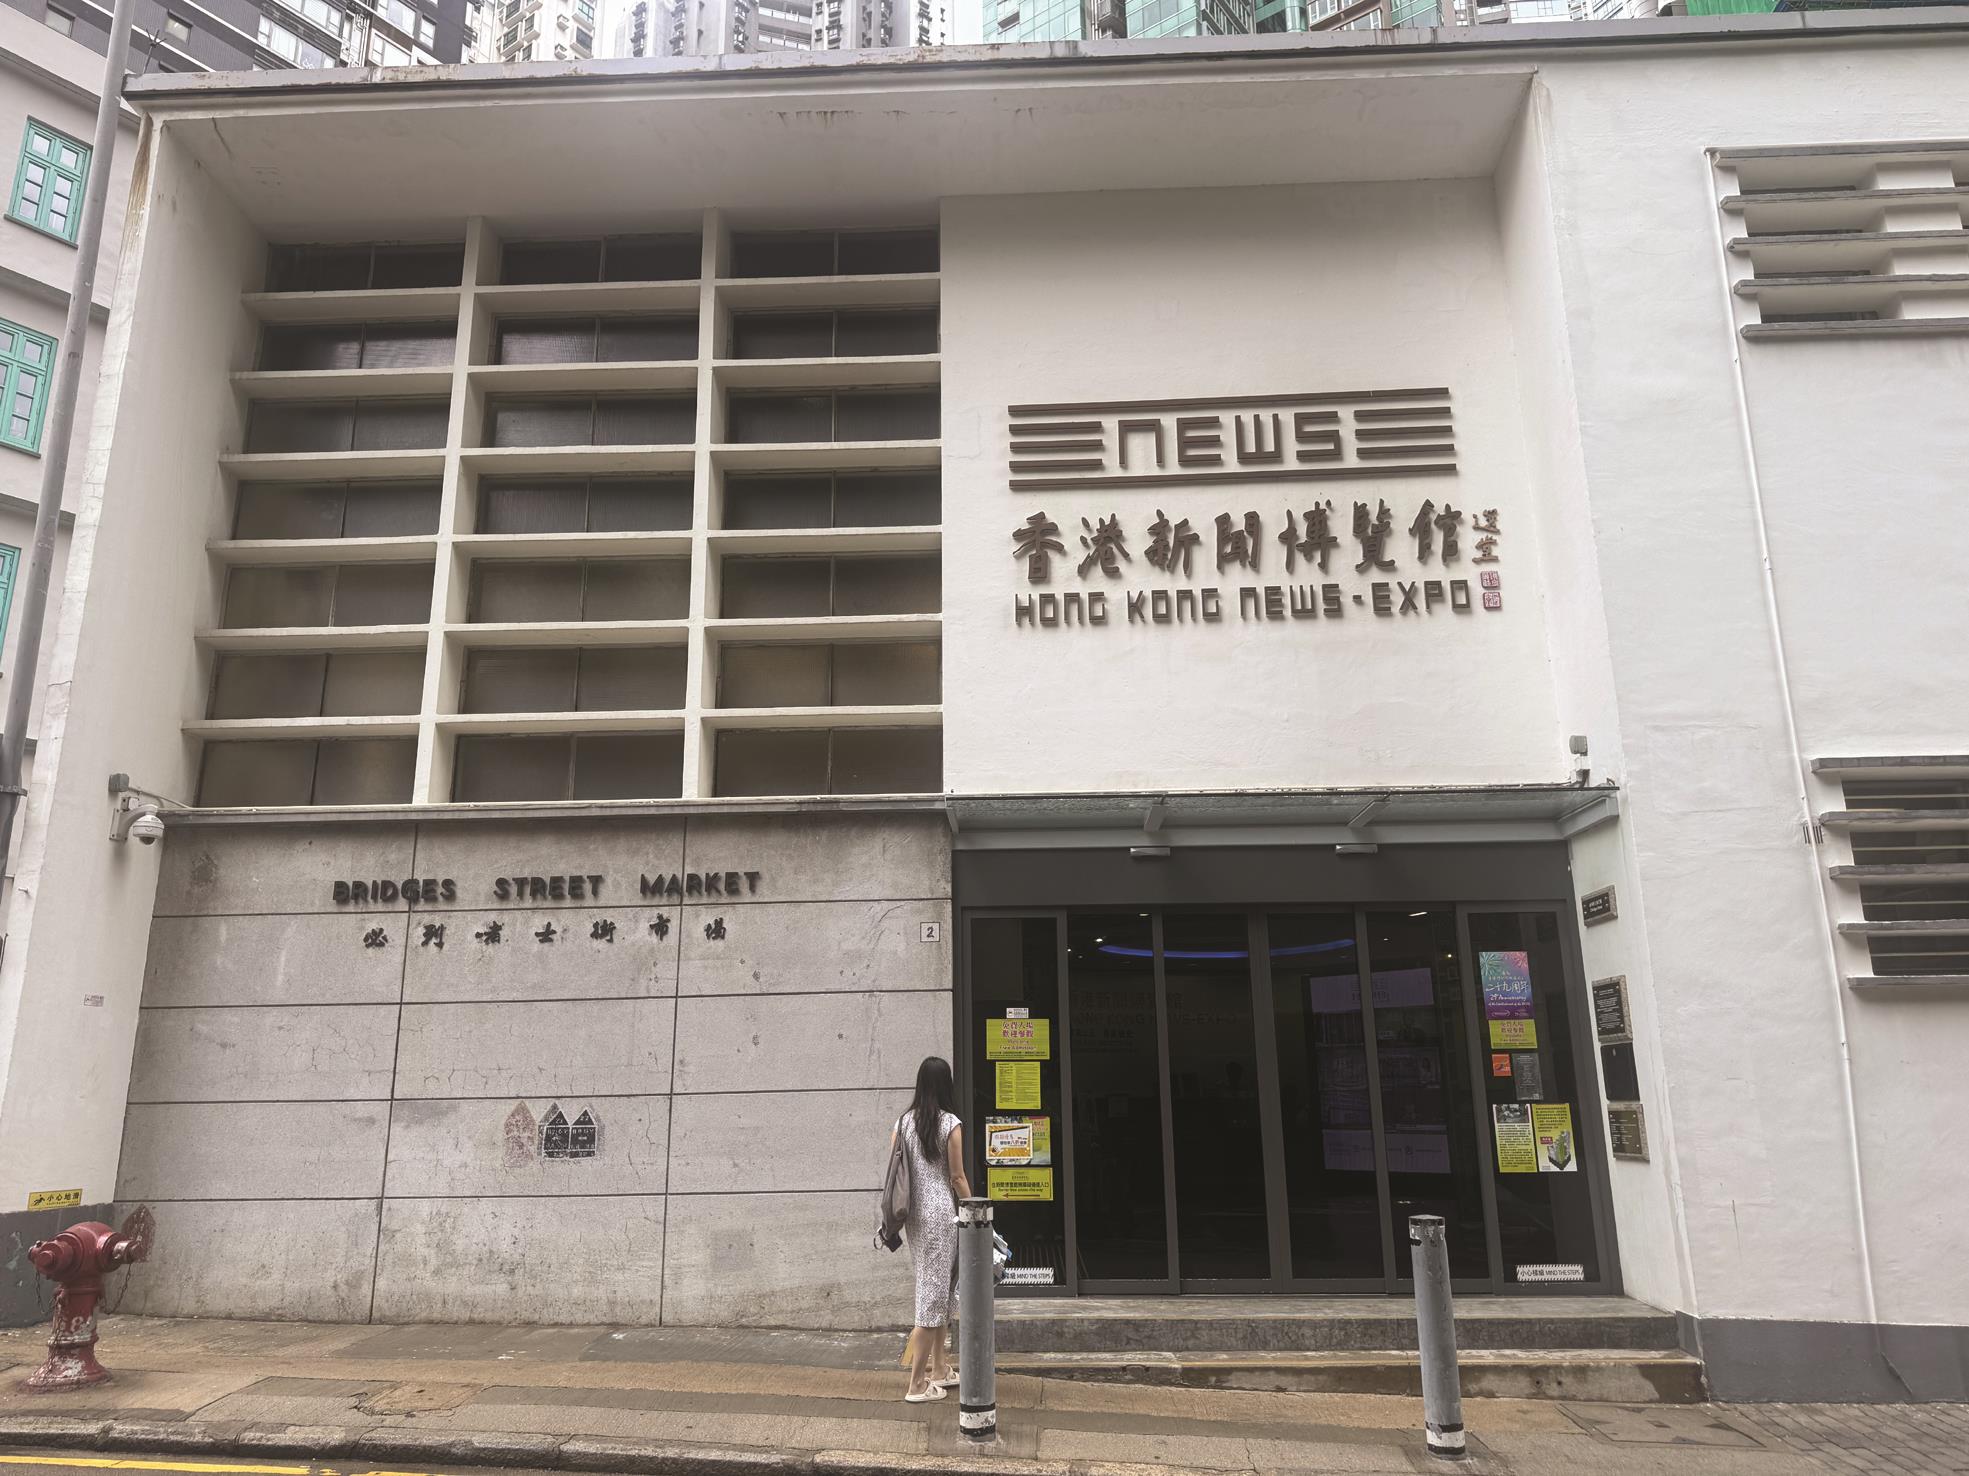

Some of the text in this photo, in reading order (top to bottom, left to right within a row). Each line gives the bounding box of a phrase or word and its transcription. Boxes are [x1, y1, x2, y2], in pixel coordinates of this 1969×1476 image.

[1117, 410, 1343, 465] NEWS
[1012, 499, 1463, 582] 香港新聞博覽館
[1014, 591, 1106, 625] HONG
[1126, 587, 1220, 623] KONG
[332, 871, 760, 902] BRIDGES STREET MARKET
[926, 926, 935, 938] 2
[46, 1191, 80, 1202] 小心地滑
